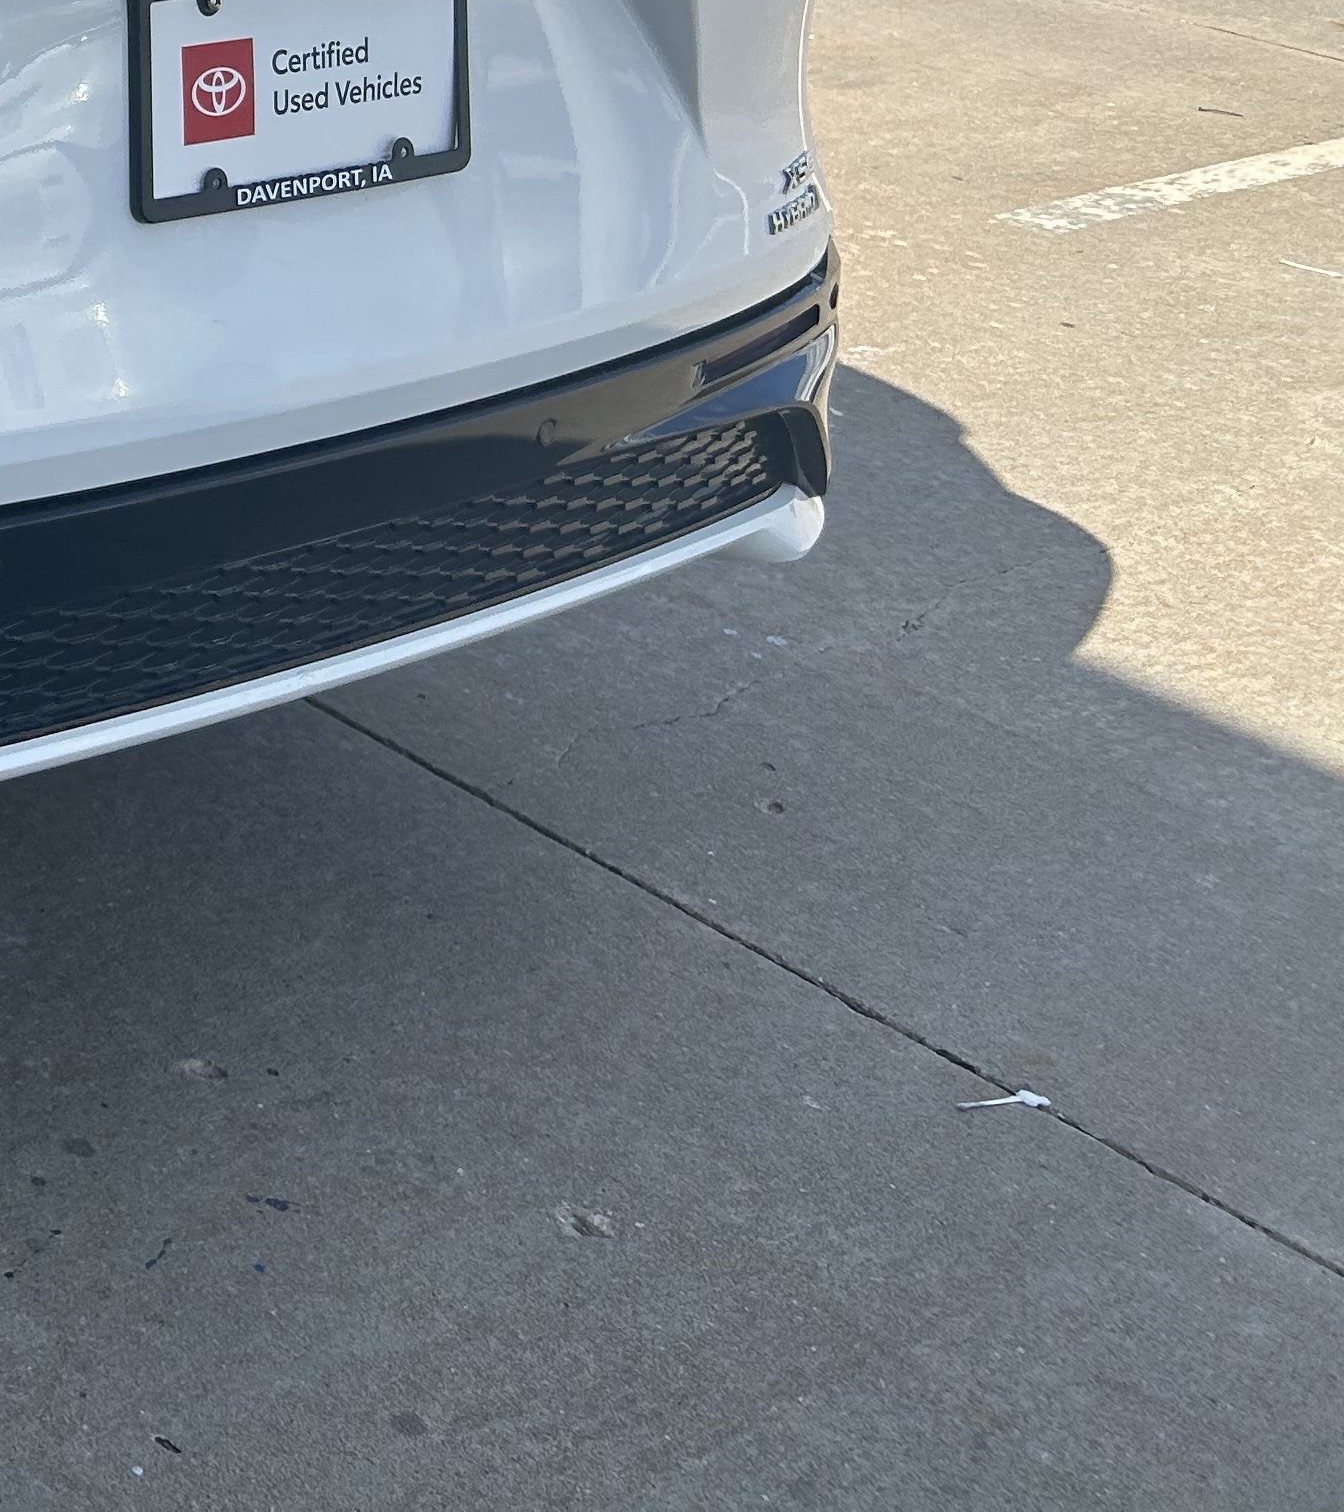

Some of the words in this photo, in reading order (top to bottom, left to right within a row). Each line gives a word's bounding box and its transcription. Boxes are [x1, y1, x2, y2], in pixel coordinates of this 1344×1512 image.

[271, 36, 369, 75] Certified
[273, 81, 329, 116] Used
[334, 71, 422, 106] Vehicles
[237, 167, 366, 206] DAVENPORT,
[372, 164, 393, 183] IA
